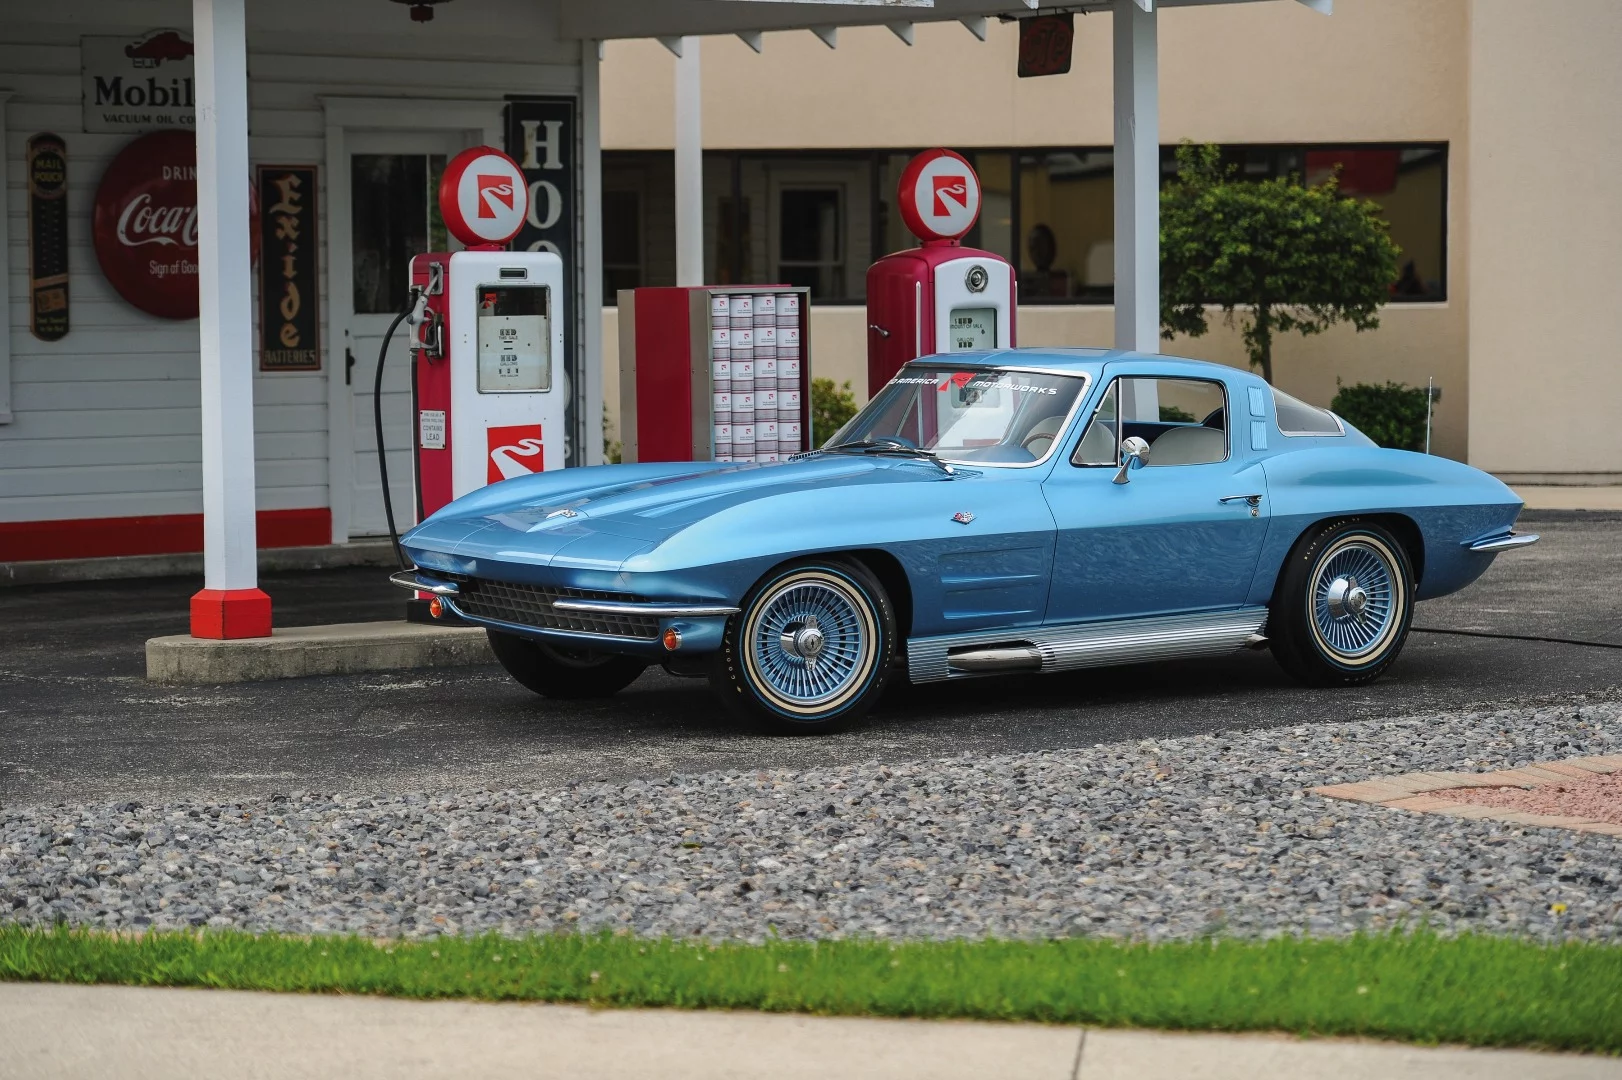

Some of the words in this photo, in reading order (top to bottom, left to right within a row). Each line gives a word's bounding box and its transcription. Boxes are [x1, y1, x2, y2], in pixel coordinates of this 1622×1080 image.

[94, 75, 195, 107] Mobil
[103, 114, 152, 124] VACUUM
[156, 114, 174, 124] OIL
[36, 159, 63, 169] MAIL
[163, 165, 197, 181] DRIN
[268, 173, 303, 348] Exide
[149, 260, 168, 279] Sign
[170, 260, 180, 274] of
[181, 260, 198, 274] Goo
[264, 349, 316, 364] BATTERIES
[973, 380, 1058, 396] MOTORWORKS
[426, 433, 440, 441] LEAD
